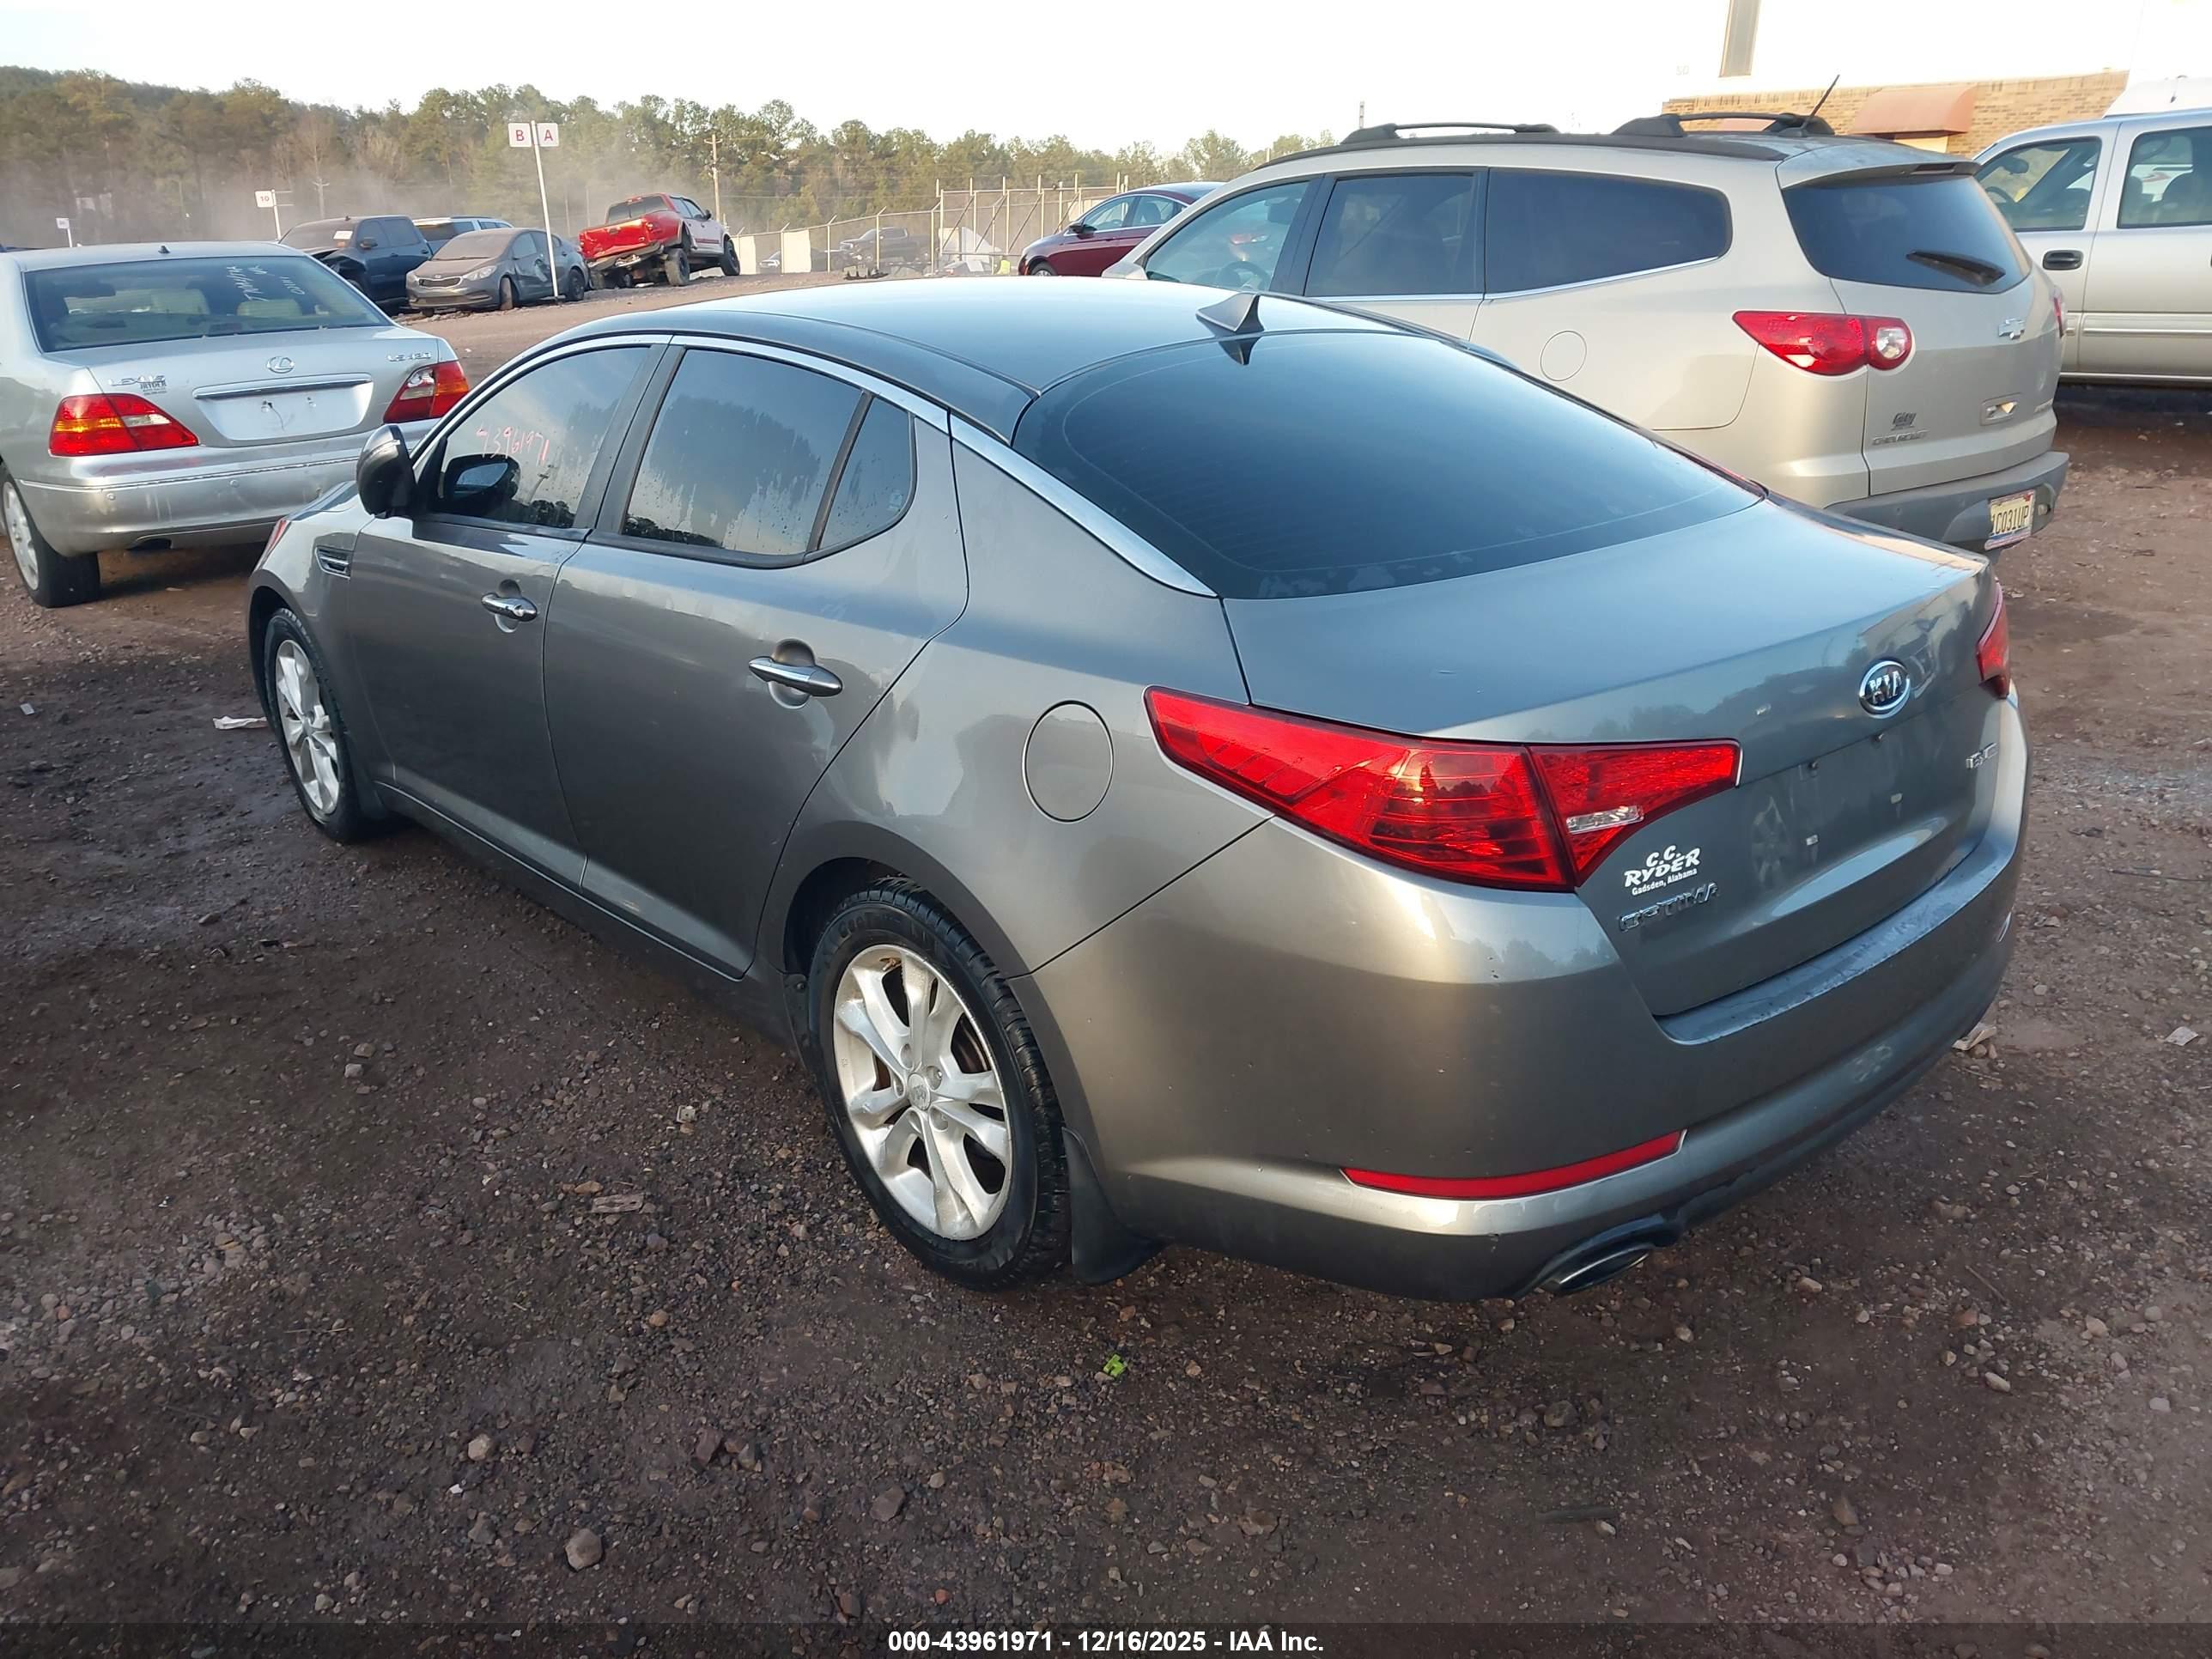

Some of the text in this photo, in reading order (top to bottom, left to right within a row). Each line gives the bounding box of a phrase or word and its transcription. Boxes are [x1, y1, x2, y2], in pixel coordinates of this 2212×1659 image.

[516, 130, 525, 142] B
[544, 129, 554, 142] A
[1868, 671, 1902, 704] KIA
[1624, 848, 1701, 887] RYDER
[1646, 845, 1682, 867] C.C.
[1632, 868, 1698, 896] Gadsden, Alabama
[1620, 882, 1718, 932] OPTIMA
